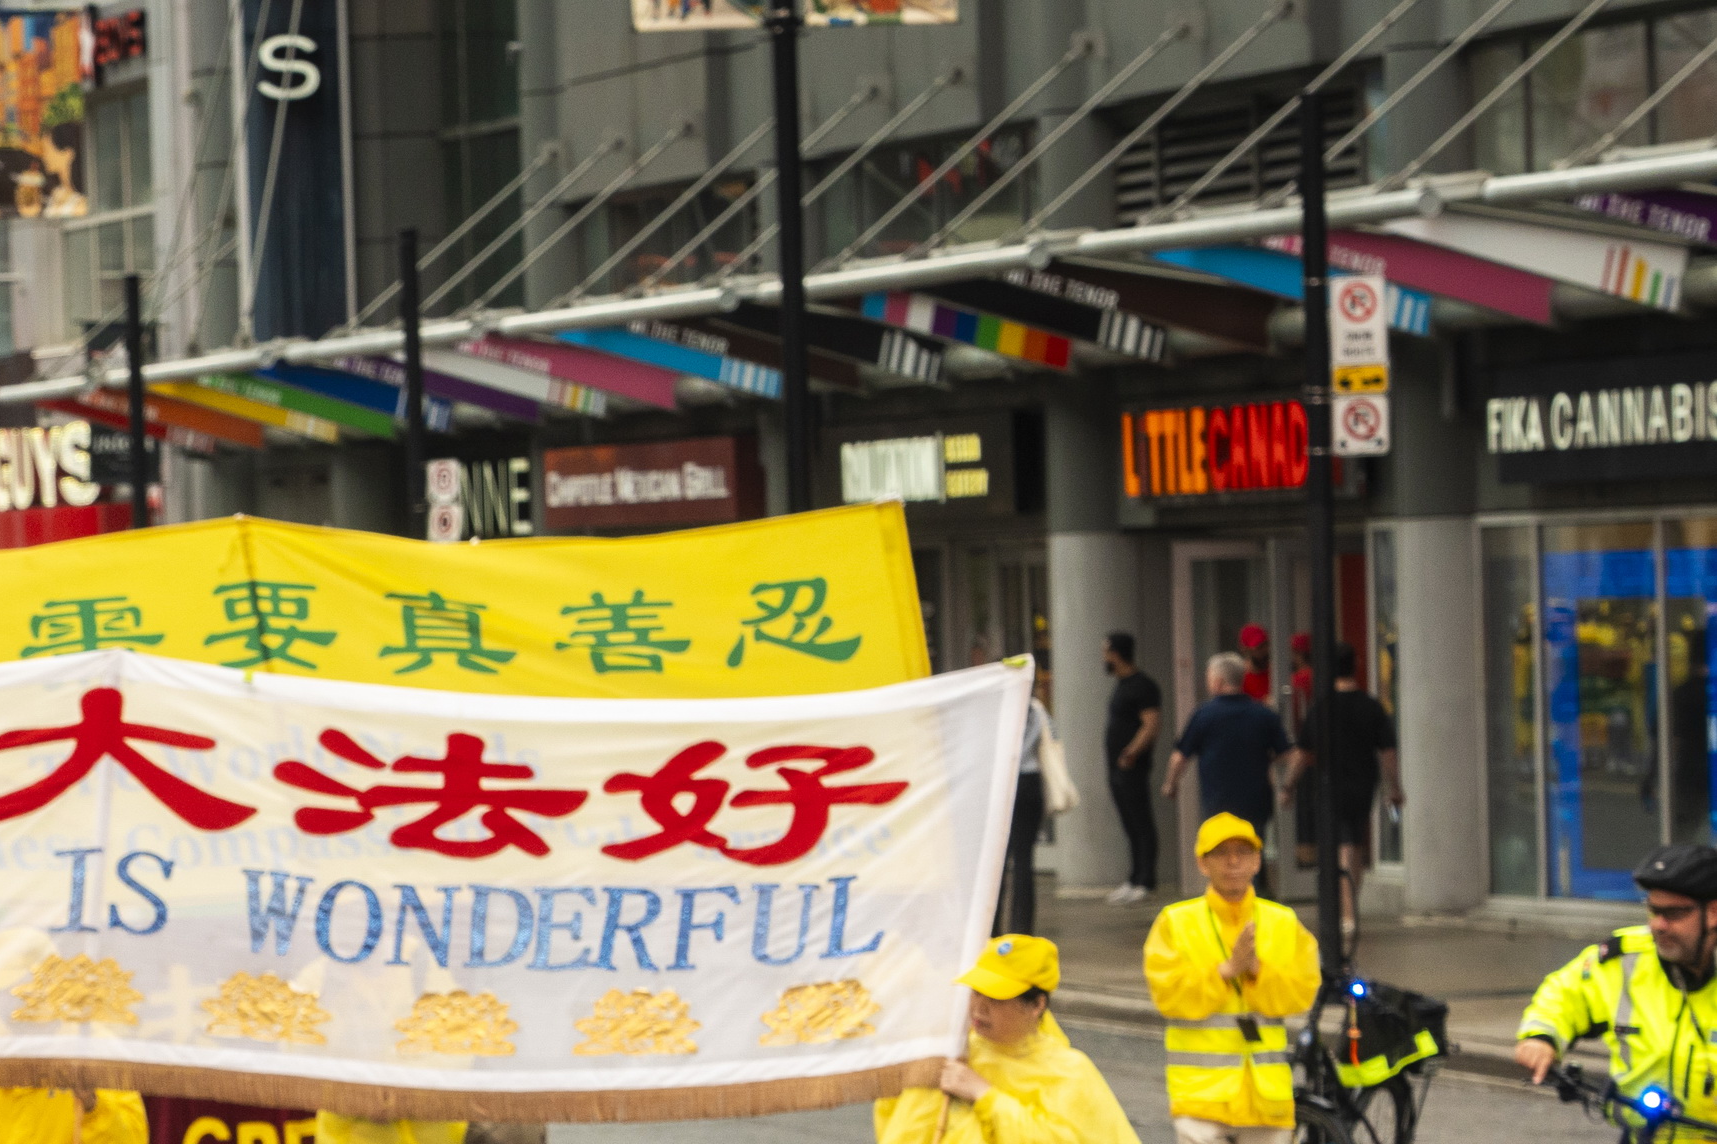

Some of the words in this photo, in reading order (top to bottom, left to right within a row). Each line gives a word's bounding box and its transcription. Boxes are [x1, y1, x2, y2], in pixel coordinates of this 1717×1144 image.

[1121, 405, 1208, 497] LITTLE
[51, 847, 174, 939] IS
[243, 868, 885, 974] WONDERFUL
